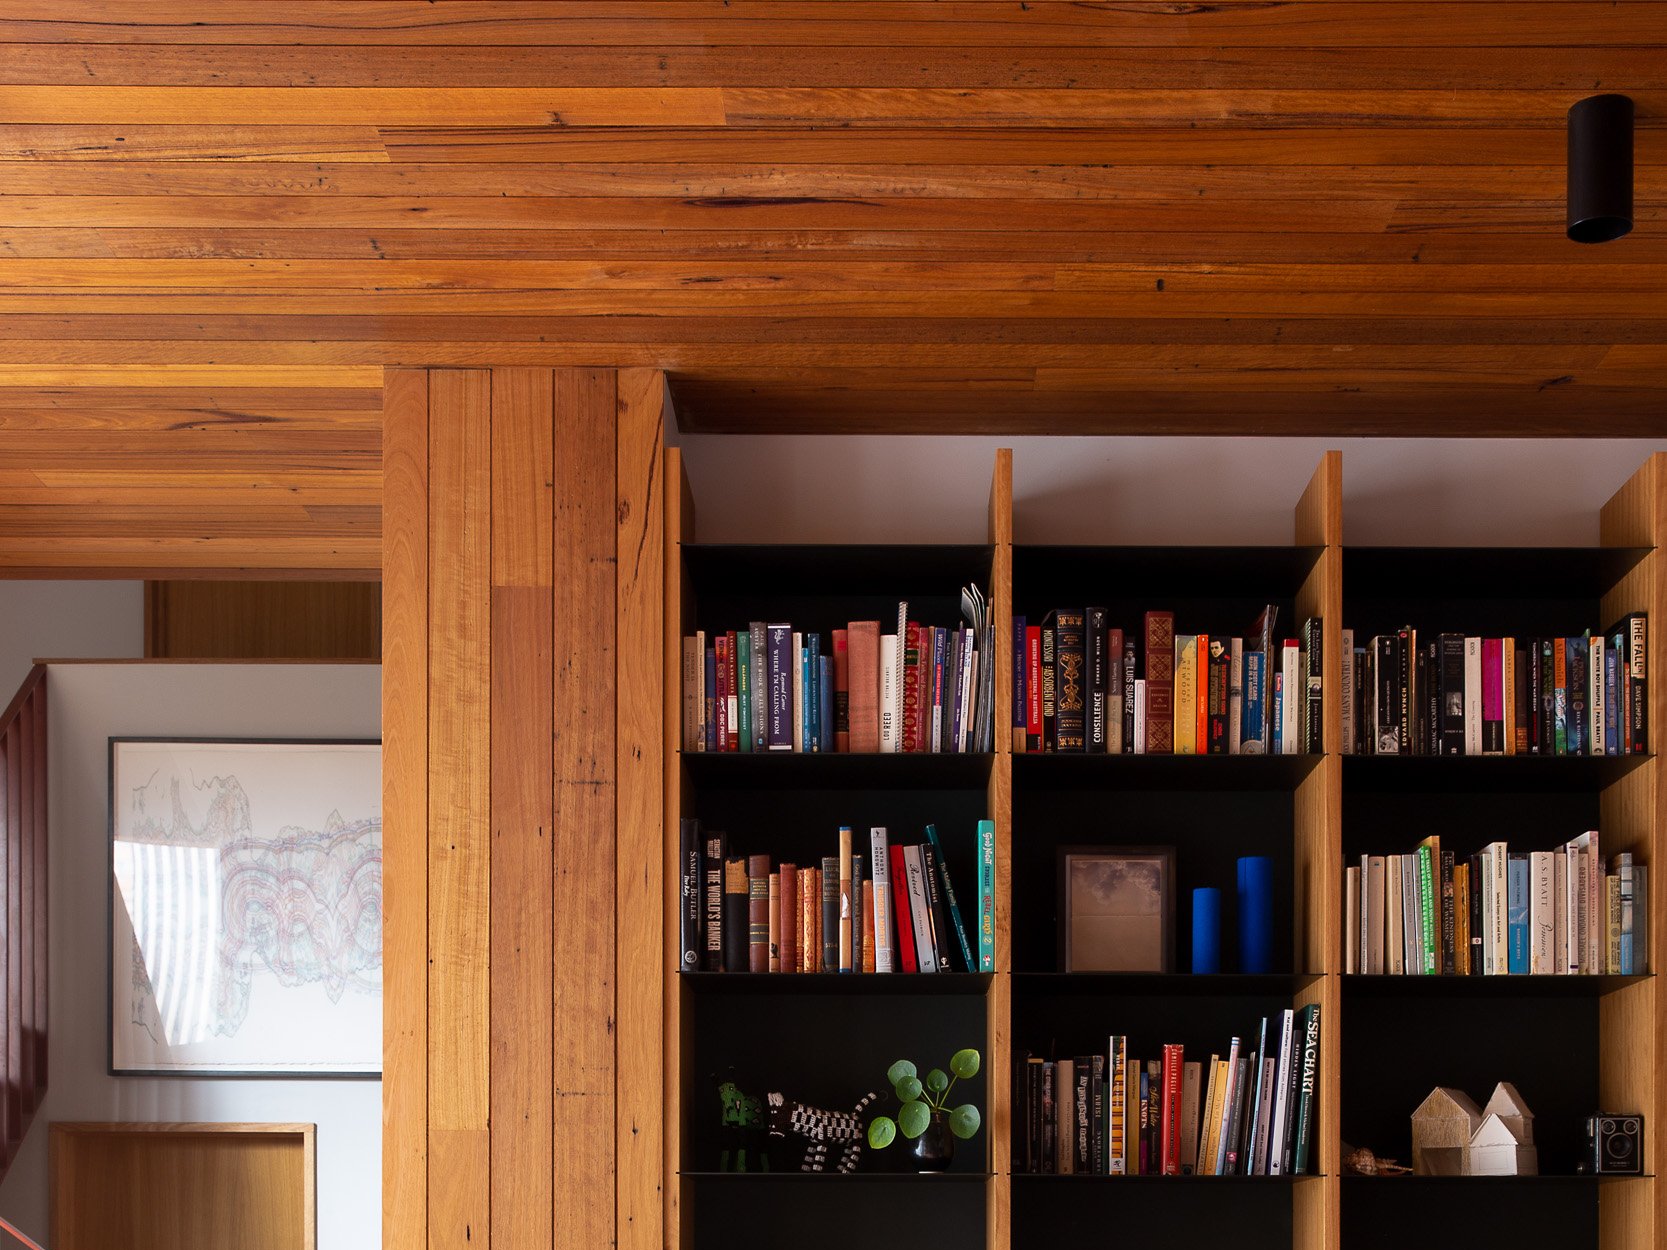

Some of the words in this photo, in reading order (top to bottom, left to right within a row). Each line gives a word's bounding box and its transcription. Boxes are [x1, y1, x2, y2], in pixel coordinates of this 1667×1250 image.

[1634, 622, 1642, 640] THE
[1044, 630, 1053, 662] MONTESSORI
[1126, 666, 1134, 684] LUIS
[1093, 692, 1102, 743] CONSILIENCE
[1342, 694, 1350, 714] MAN'S
[883, 712, 891, 730] REED
[883, 731, 891, 741] LOU
[1541, 856, 1548, 864] A.
[708, 870, 720, 884] THE
[928, 867, 938, 903] Anatomist
[1580, 867, 1588, 904] DIVISADERO
[708, 886, 721, 919] WORLD'S
[878, 886, 886, 916] TRIGGER
[1580, 905, 1588, 938] ONDAATJE
[708, 922, 721, 951] BANKER
[1579, 938, 1587, 964] MICHAEL
[1306, 1021, 1318, 1048] SEA
[1302, 1047, 1316, 1096] CHART
